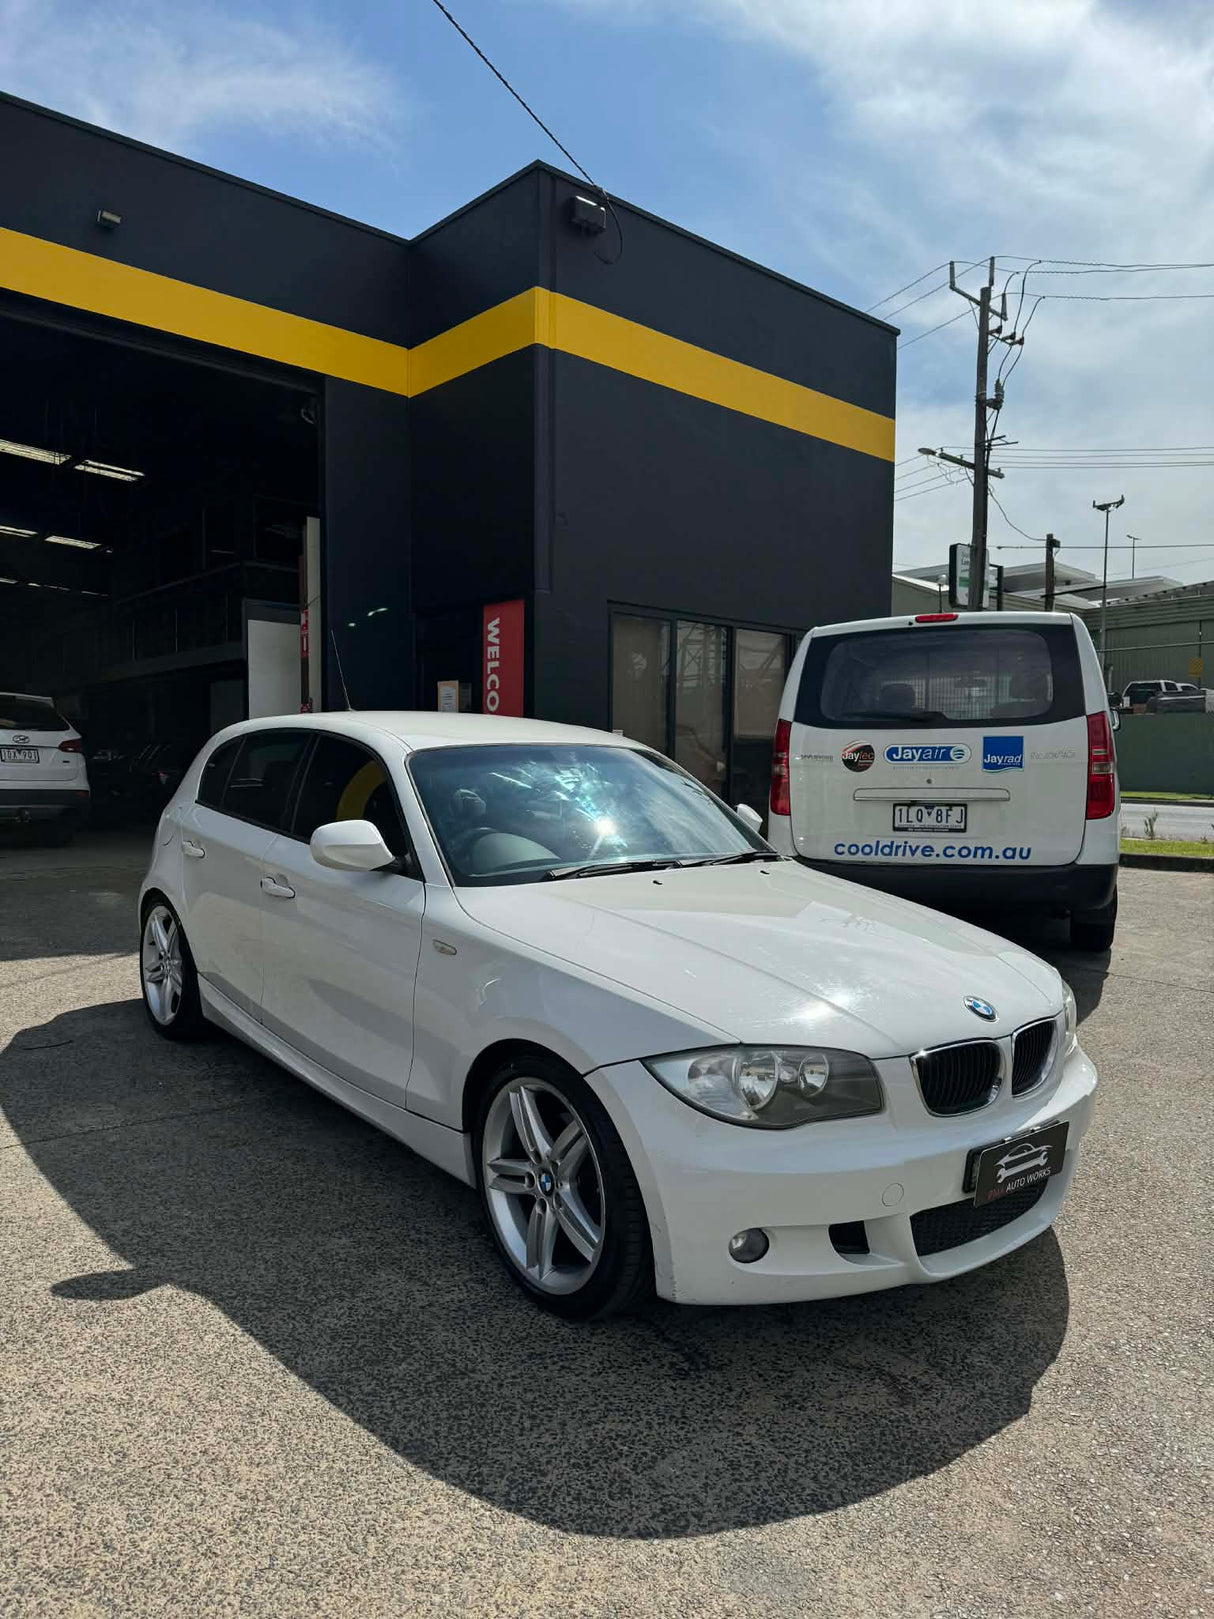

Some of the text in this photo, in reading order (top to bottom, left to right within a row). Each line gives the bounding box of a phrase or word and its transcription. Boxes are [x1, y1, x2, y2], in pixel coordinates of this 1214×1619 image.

[487, 618, 500, 712] WELCO
[892, 745, 947, 762] Jayair
[984, 753, 1022, 765] Jayrad
[834, 840, 1032, 860] cooldrive.com.au
[1006, 1177, 1025, 1192] AUTO
[1026, 1168, 1051, 1183] WORKS
